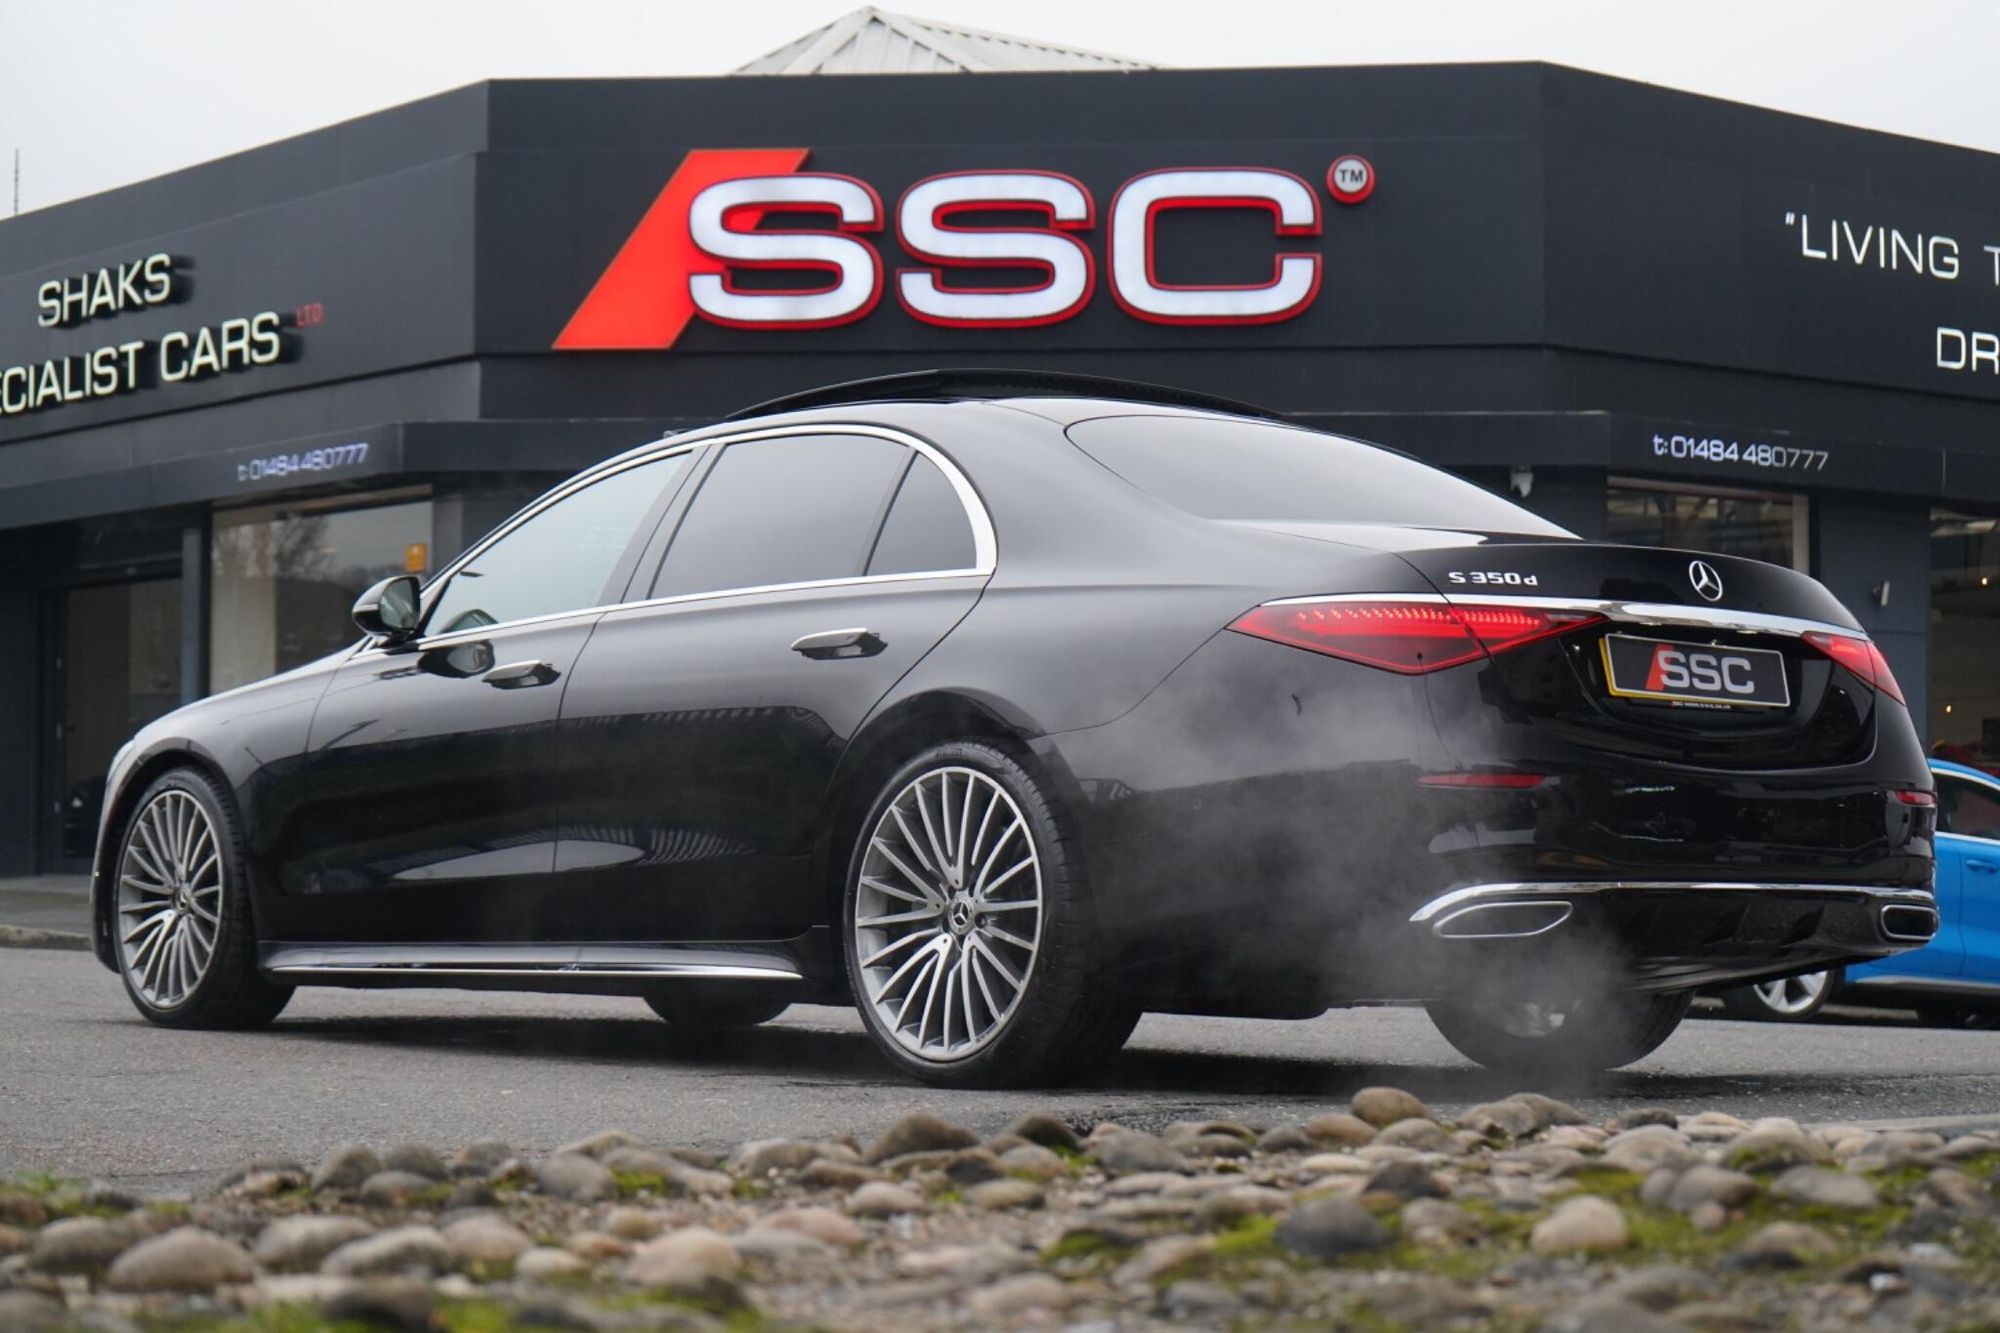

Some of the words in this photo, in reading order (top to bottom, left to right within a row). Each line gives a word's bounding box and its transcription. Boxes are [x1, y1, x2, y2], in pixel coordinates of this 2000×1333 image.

[1338, 168, 1364, 183] TM
[686, 168, 1322, 329] SSC
[37, 253, 171, 328] SHAKS
[0, 340, 145, 416] CIALIST
[160, 311, 280, 382] CARS
[1936, 326, 2000, 376] DR
[1448, 571, 1466, 584] S
[1469, 571, 1538, 586] 350d
[1657, 650, 1755, 694] SSC
